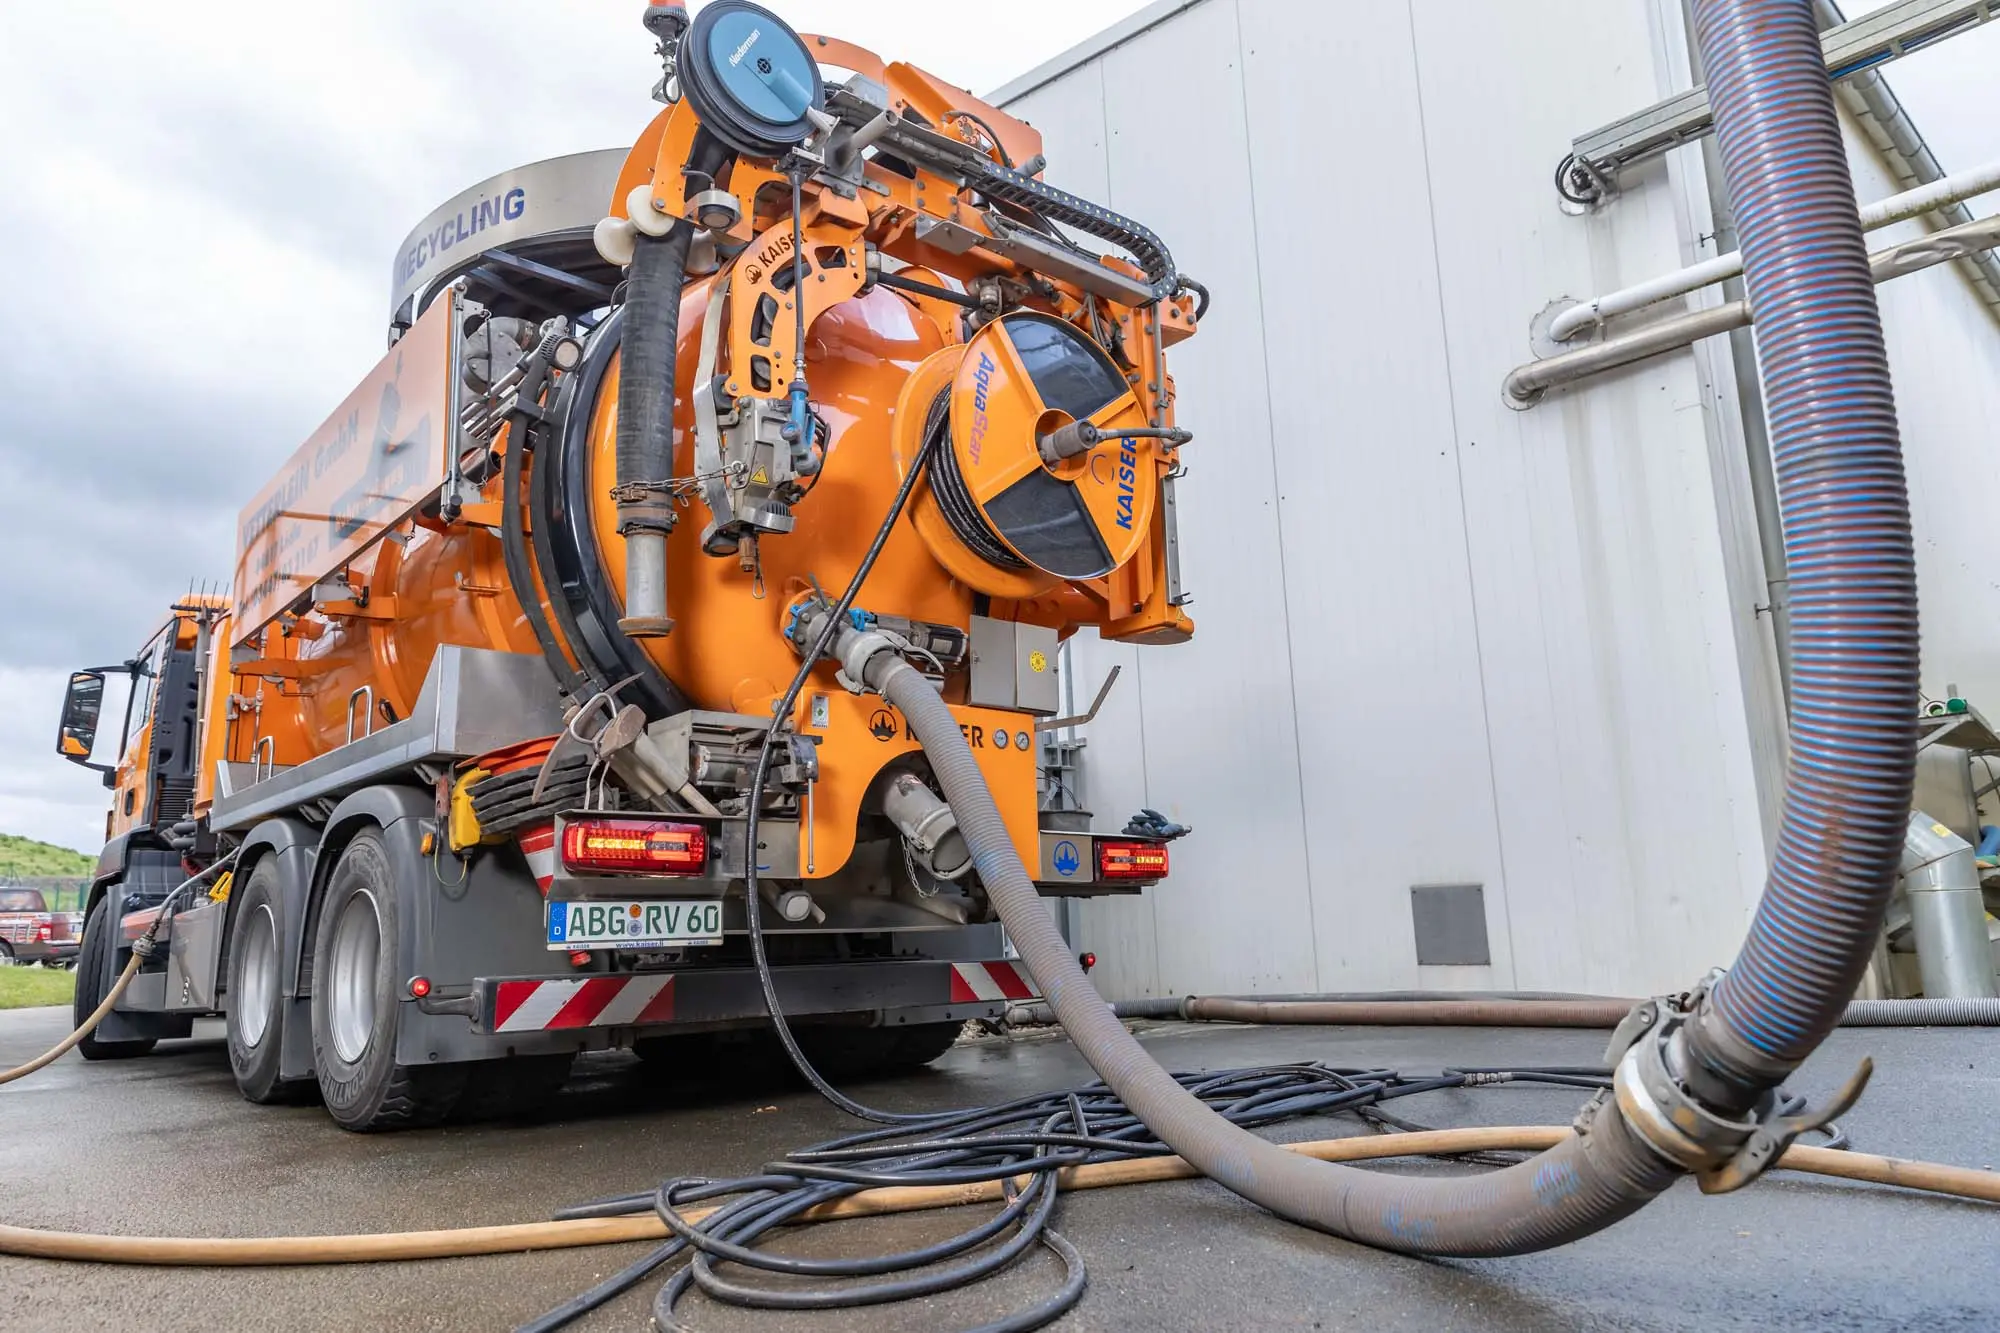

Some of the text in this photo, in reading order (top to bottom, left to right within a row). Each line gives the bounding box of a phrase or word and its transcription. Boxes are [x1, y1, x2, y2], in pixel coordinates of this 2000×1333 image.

[728, 28, 760, 67] Nederman
[969, 351, 996, 466] AquaStar
[1116, 436, 1138, 531] KAISER
[554, 926, 561, 935] D
[568, 905, 719, 936] ABG RV 60
